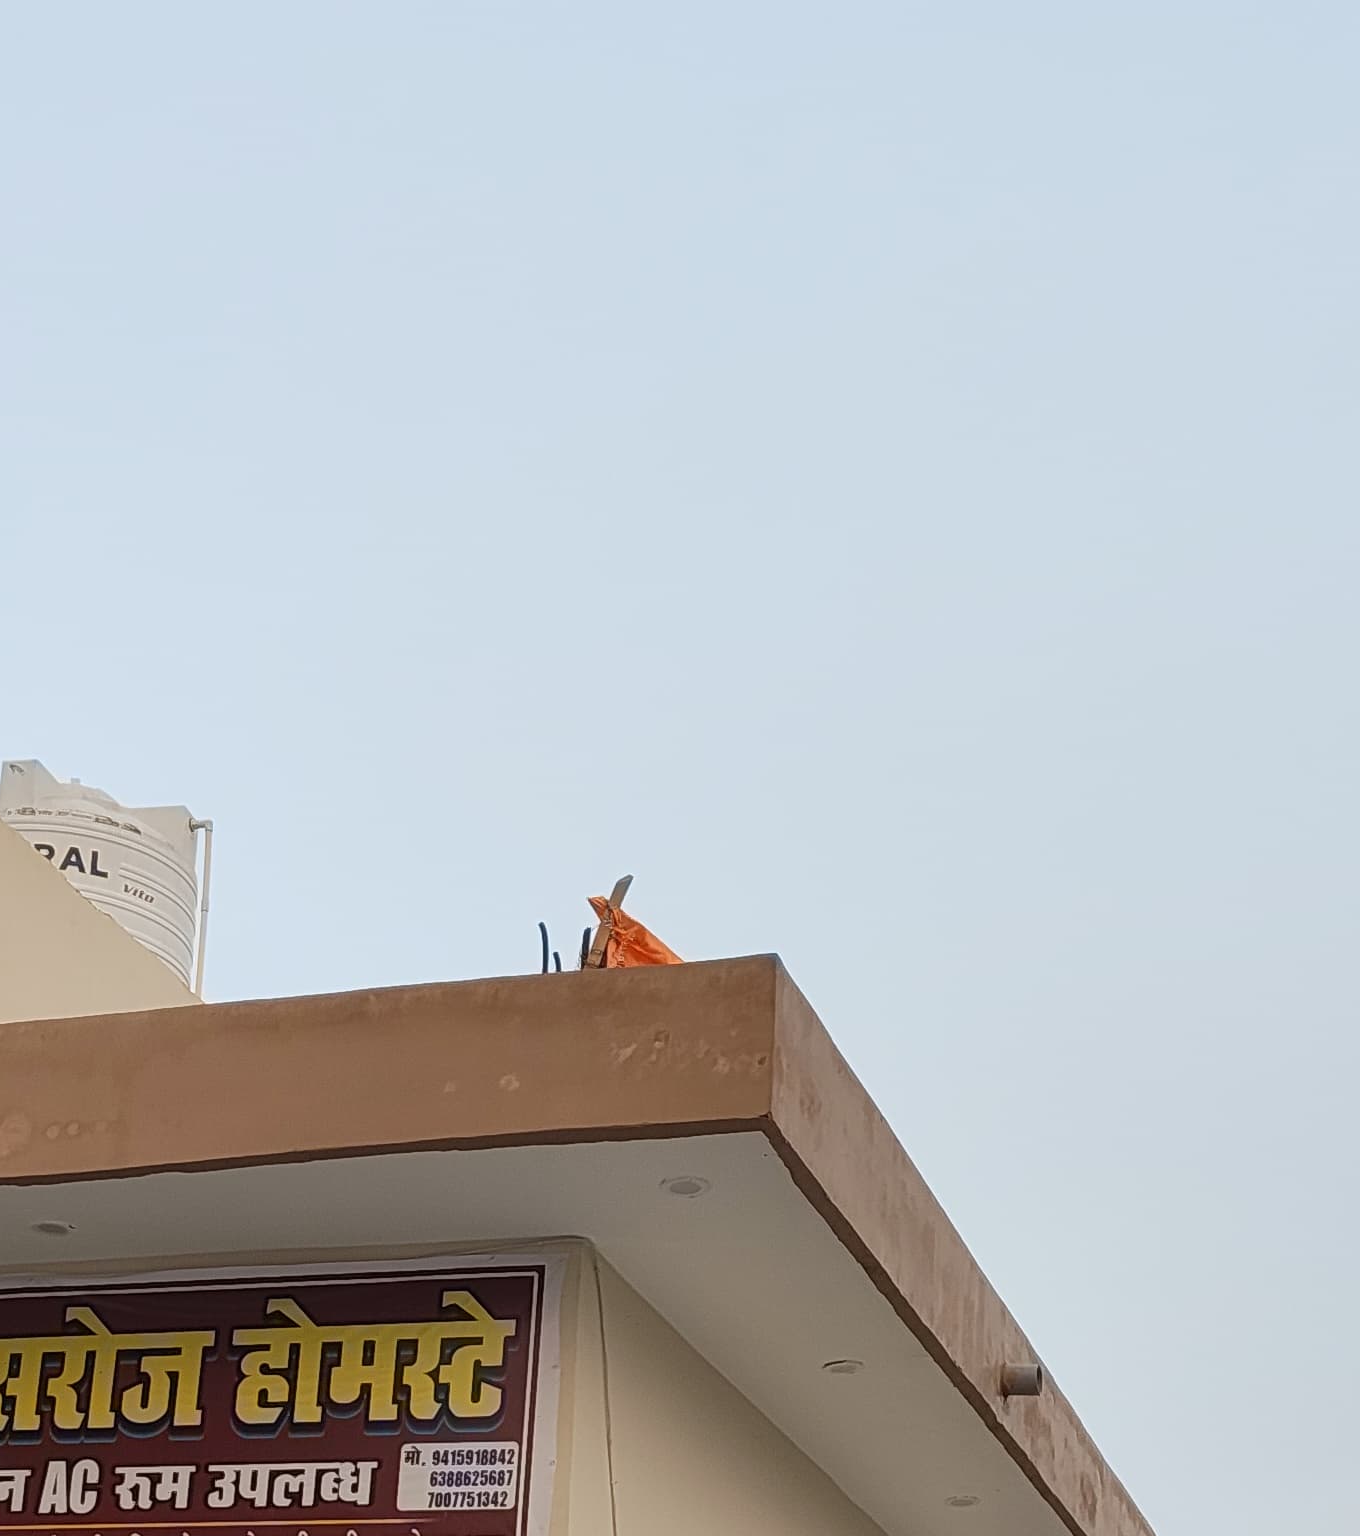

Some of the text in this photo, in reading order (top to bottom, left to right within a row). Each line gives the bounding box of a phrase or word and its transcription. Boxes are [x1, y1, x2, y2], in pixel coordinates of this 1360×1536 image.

[232, 1290, 517, 1425] होमस्टे
[431, 1448, 515, 1466] 9415918842
[37, 1459, 101, 1515] AC
[114, 1465, 197, 1510] रूम
[206, 1461, 379, 1509] उपलब्ध
[429, 1469, 514, 1488] 6388625687
[427, 1490, 509, 1508] 7007751342
